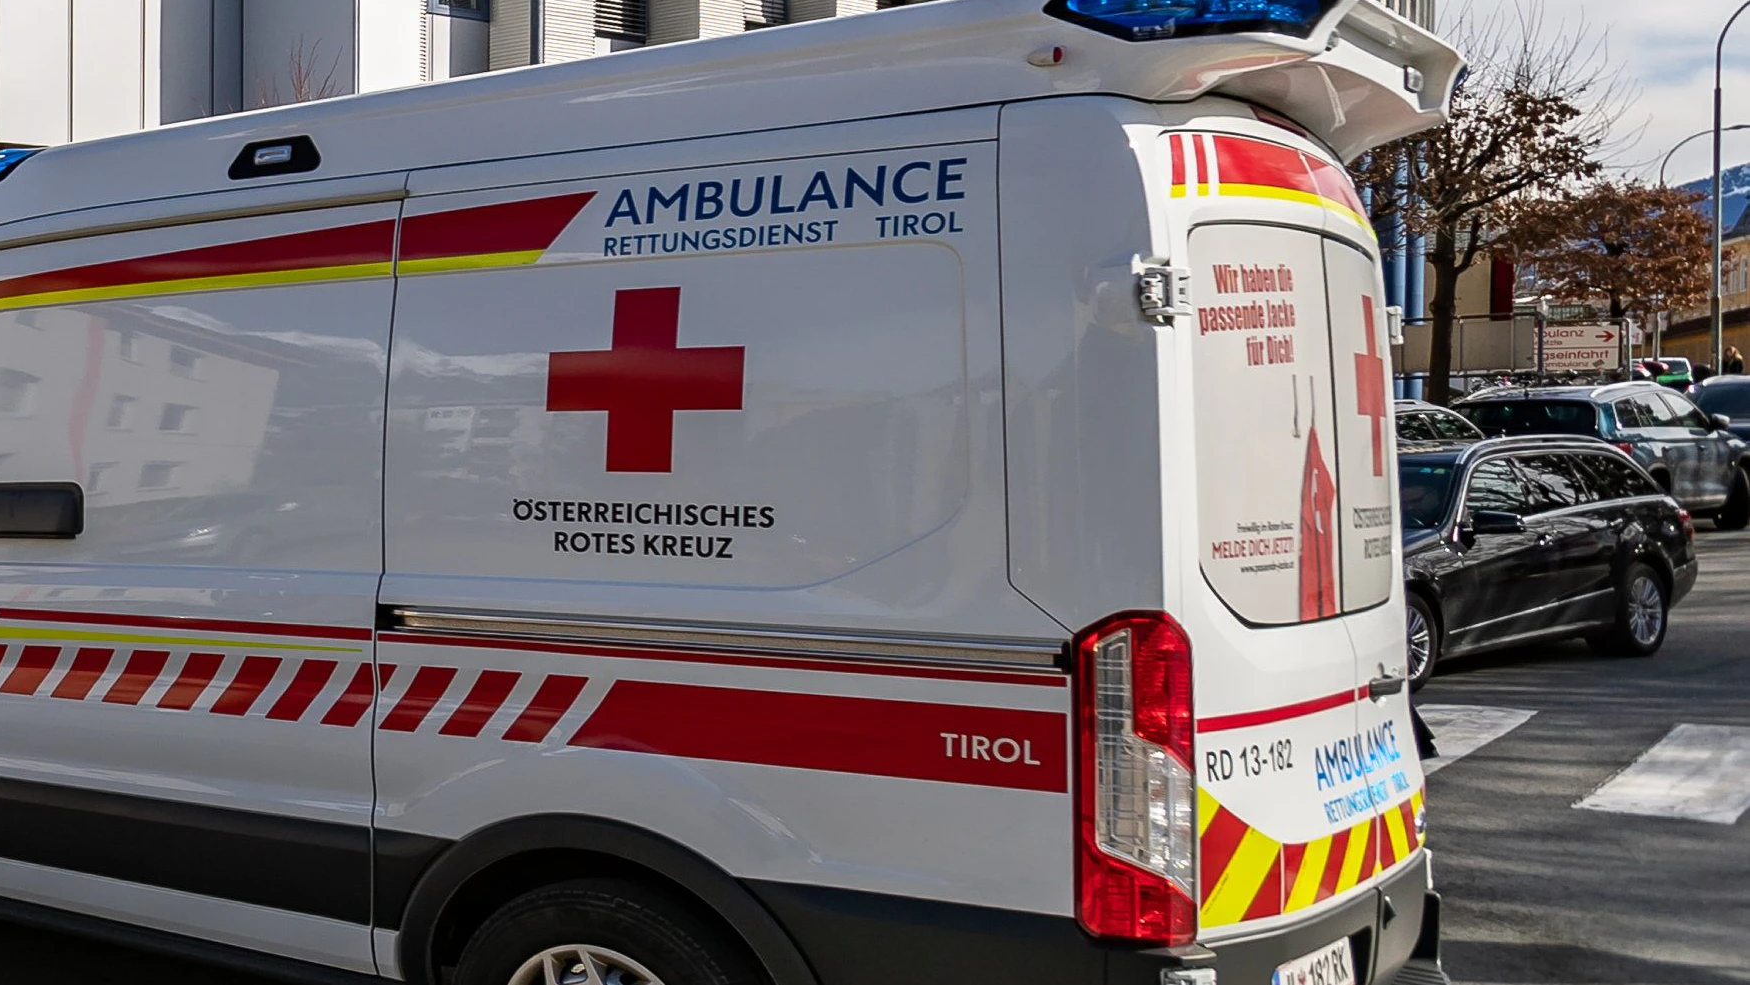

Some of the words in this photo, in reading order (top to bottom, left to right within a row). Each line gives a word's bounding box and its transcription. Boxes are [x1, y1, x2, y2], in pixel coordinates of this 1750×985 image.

[604, 157, 968, 228] AMBULANCE
[604, 220, 839, 257] RETTUNGSDIENST
[875, 211, 964, 238] TIROL
[1212, 263, 1238, 294] Wir
[1239, 263, 1277, 293] haben
[1277, 263, 1293, 292] die
[1197, 300, 1265, 336] passende
[1266, 299, 1295, 328] Jacke
[1246, 336, 1264, 366] für
[512, 498, 775, 529] ÖSTERREICHISCHES
[553, 531, 635, 555] ROTES
[642, 534, 734, 559] KREUZ
[1212, 539, 1247, 559] MELDE
[939, 732, 1041, 766] TIROL
[1206, 749, 1234, 782] RD
[1239, 738, 1293, 777] 13-182
[1315, 719, 1401, 791] AMBULANCE
[1331, 945, 1349, 984] RK
